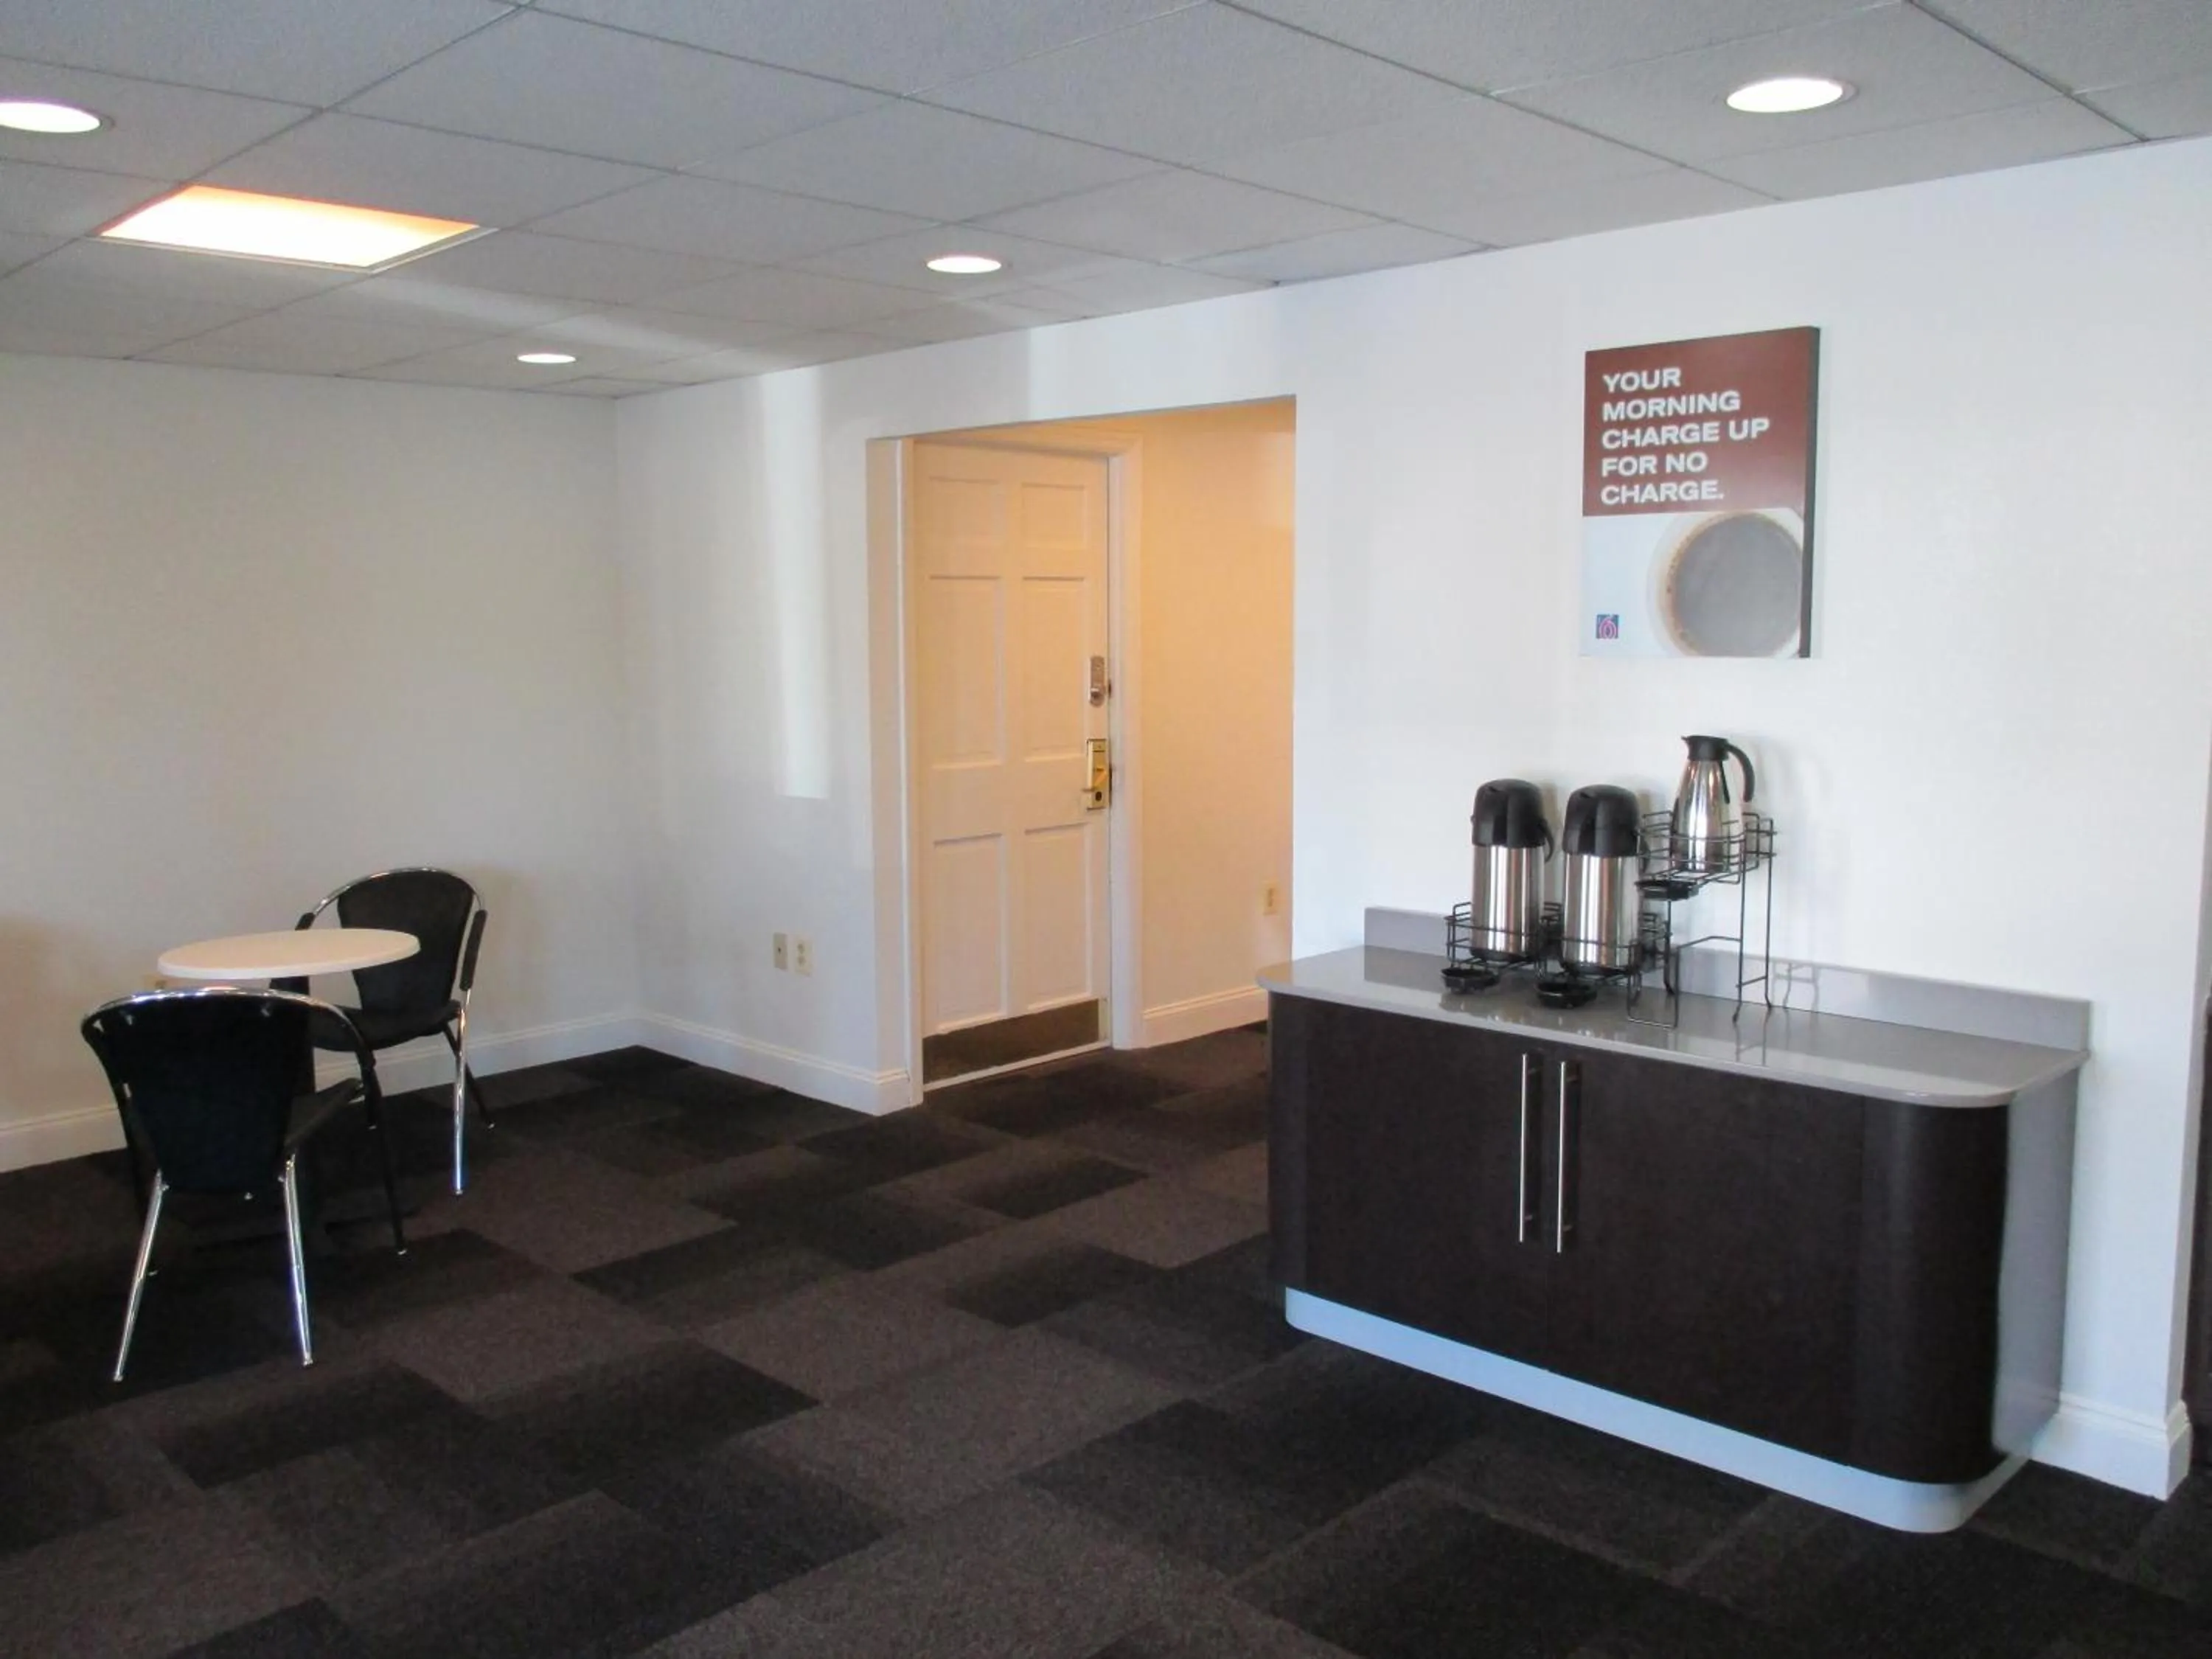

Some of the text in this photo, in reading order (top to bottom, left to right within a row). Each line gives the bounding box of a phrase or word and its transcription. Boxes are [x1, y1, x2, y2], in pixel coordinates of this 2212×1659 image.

[1602, 367, 1681, 392] YOUR
[1602, 390, 1740, 421] MORNING
[1601, 418, 1770, 449] CHARGE UP
[1601, 452, 1708, 477] FOR NO
[1601, 480, 1724, 504] CHARGE.
